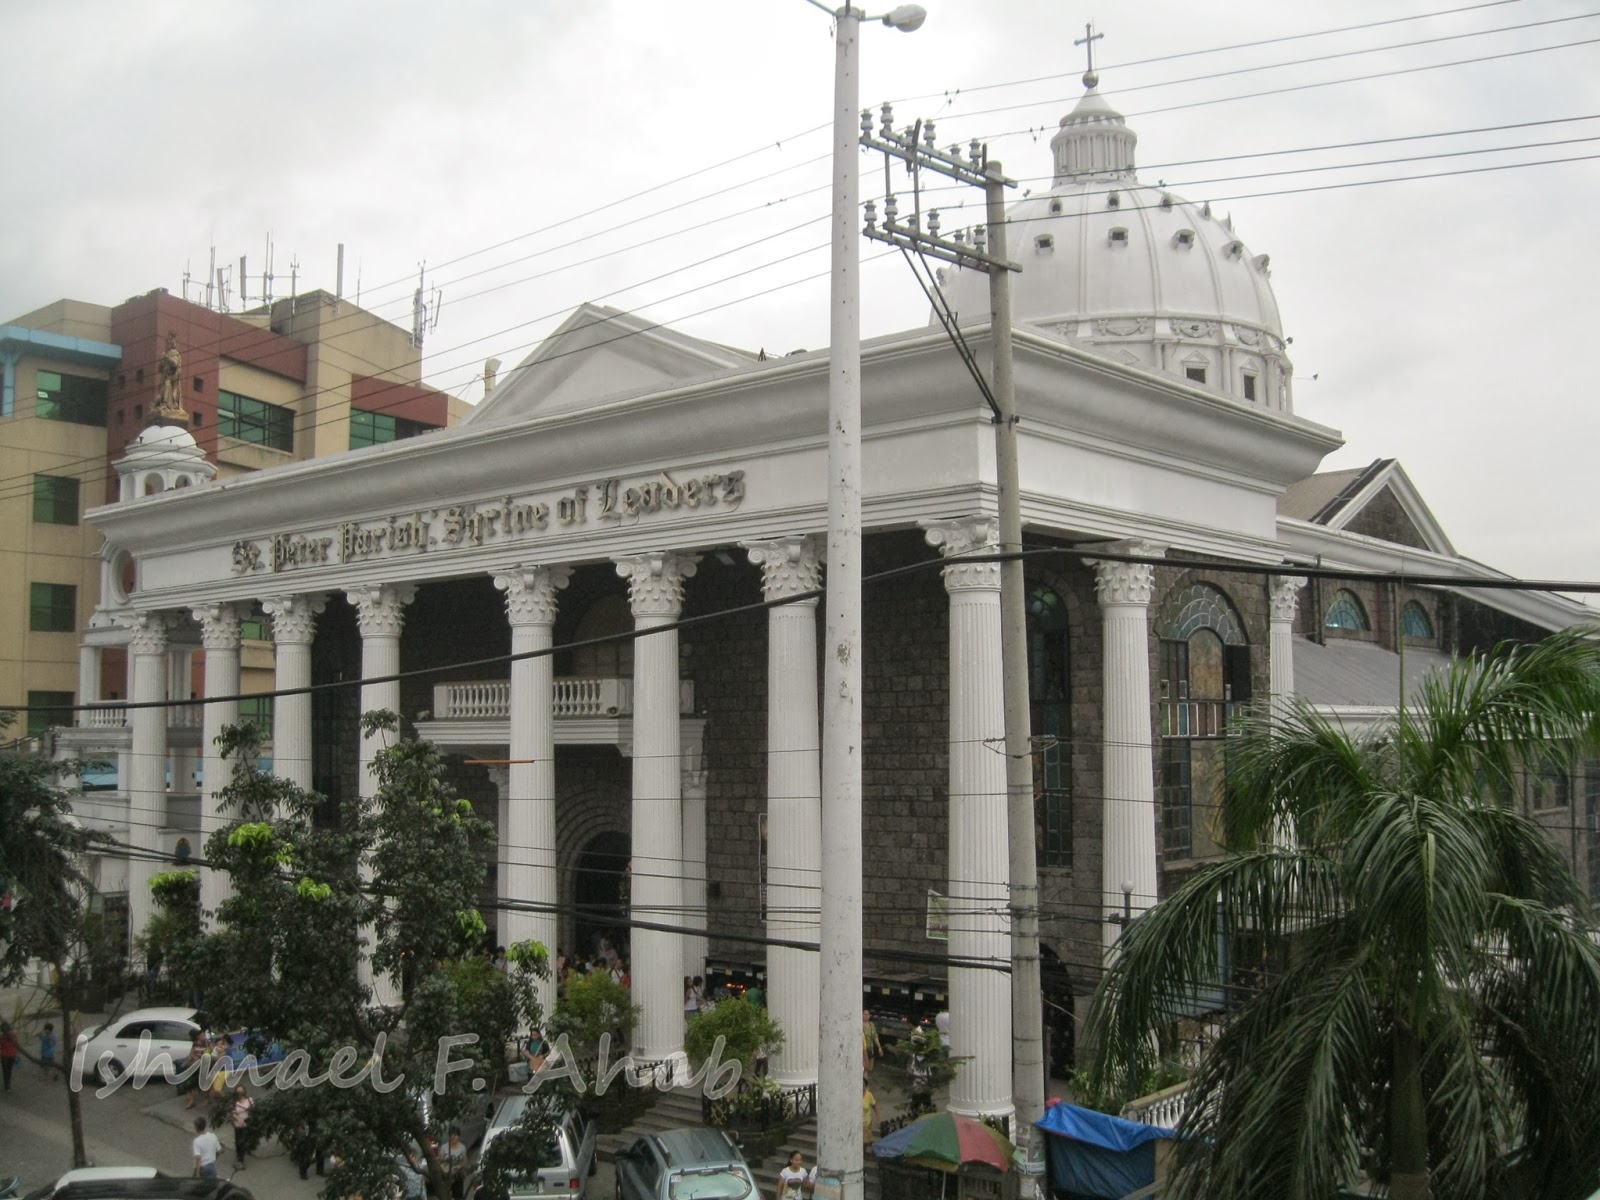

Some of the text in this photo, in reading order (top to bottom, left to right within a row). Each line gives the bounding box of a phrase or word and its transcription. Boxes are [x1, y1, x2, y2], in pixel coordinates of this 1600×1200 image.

[269, 533, 332, 573] Peter
[441, 496, 549, 546] Shrine
[556, 485, 590, 526] of
[596, 469, 745, 522] Leaders
